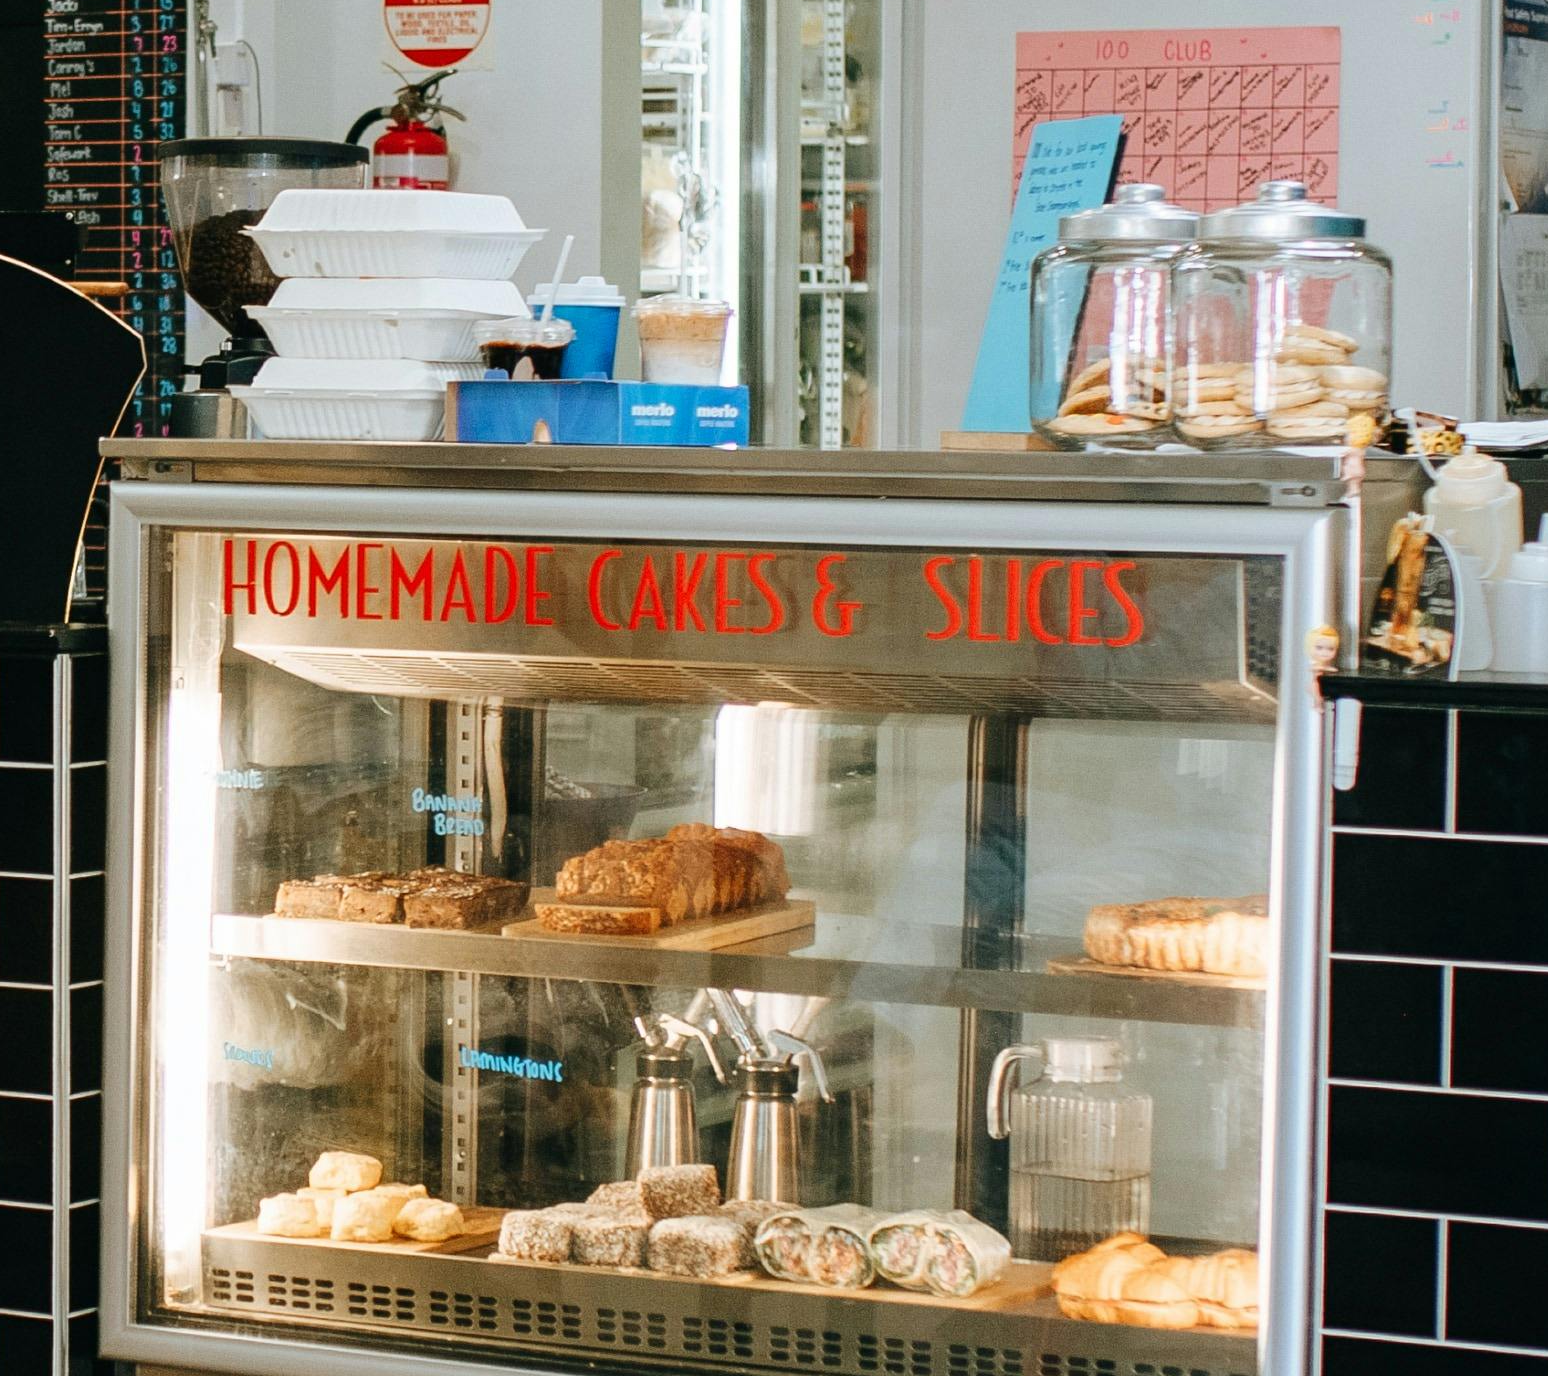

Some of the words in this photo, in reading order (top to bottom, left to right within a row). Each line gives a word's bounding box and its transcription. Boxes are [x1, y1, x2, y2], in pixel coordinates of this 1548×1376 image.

[1095, 39, 1130, 61] 100
[1164, 39, 1212, 61] CLUB
[631, 402, 675, 416] merlo
[696, 404, 739, 418] merlo
[223, 539, 555, 626] HOMEMADE
[587, 549, 786, 635] CAKES
[811, 553, 863, 638] &
[923, 556, 1145, 648] SLICES
[412, 788, 483, 812] BANANA
[434, 813, 485, 836] BREAD
[460, 1046, 564, 1084] LAMINGTONS
